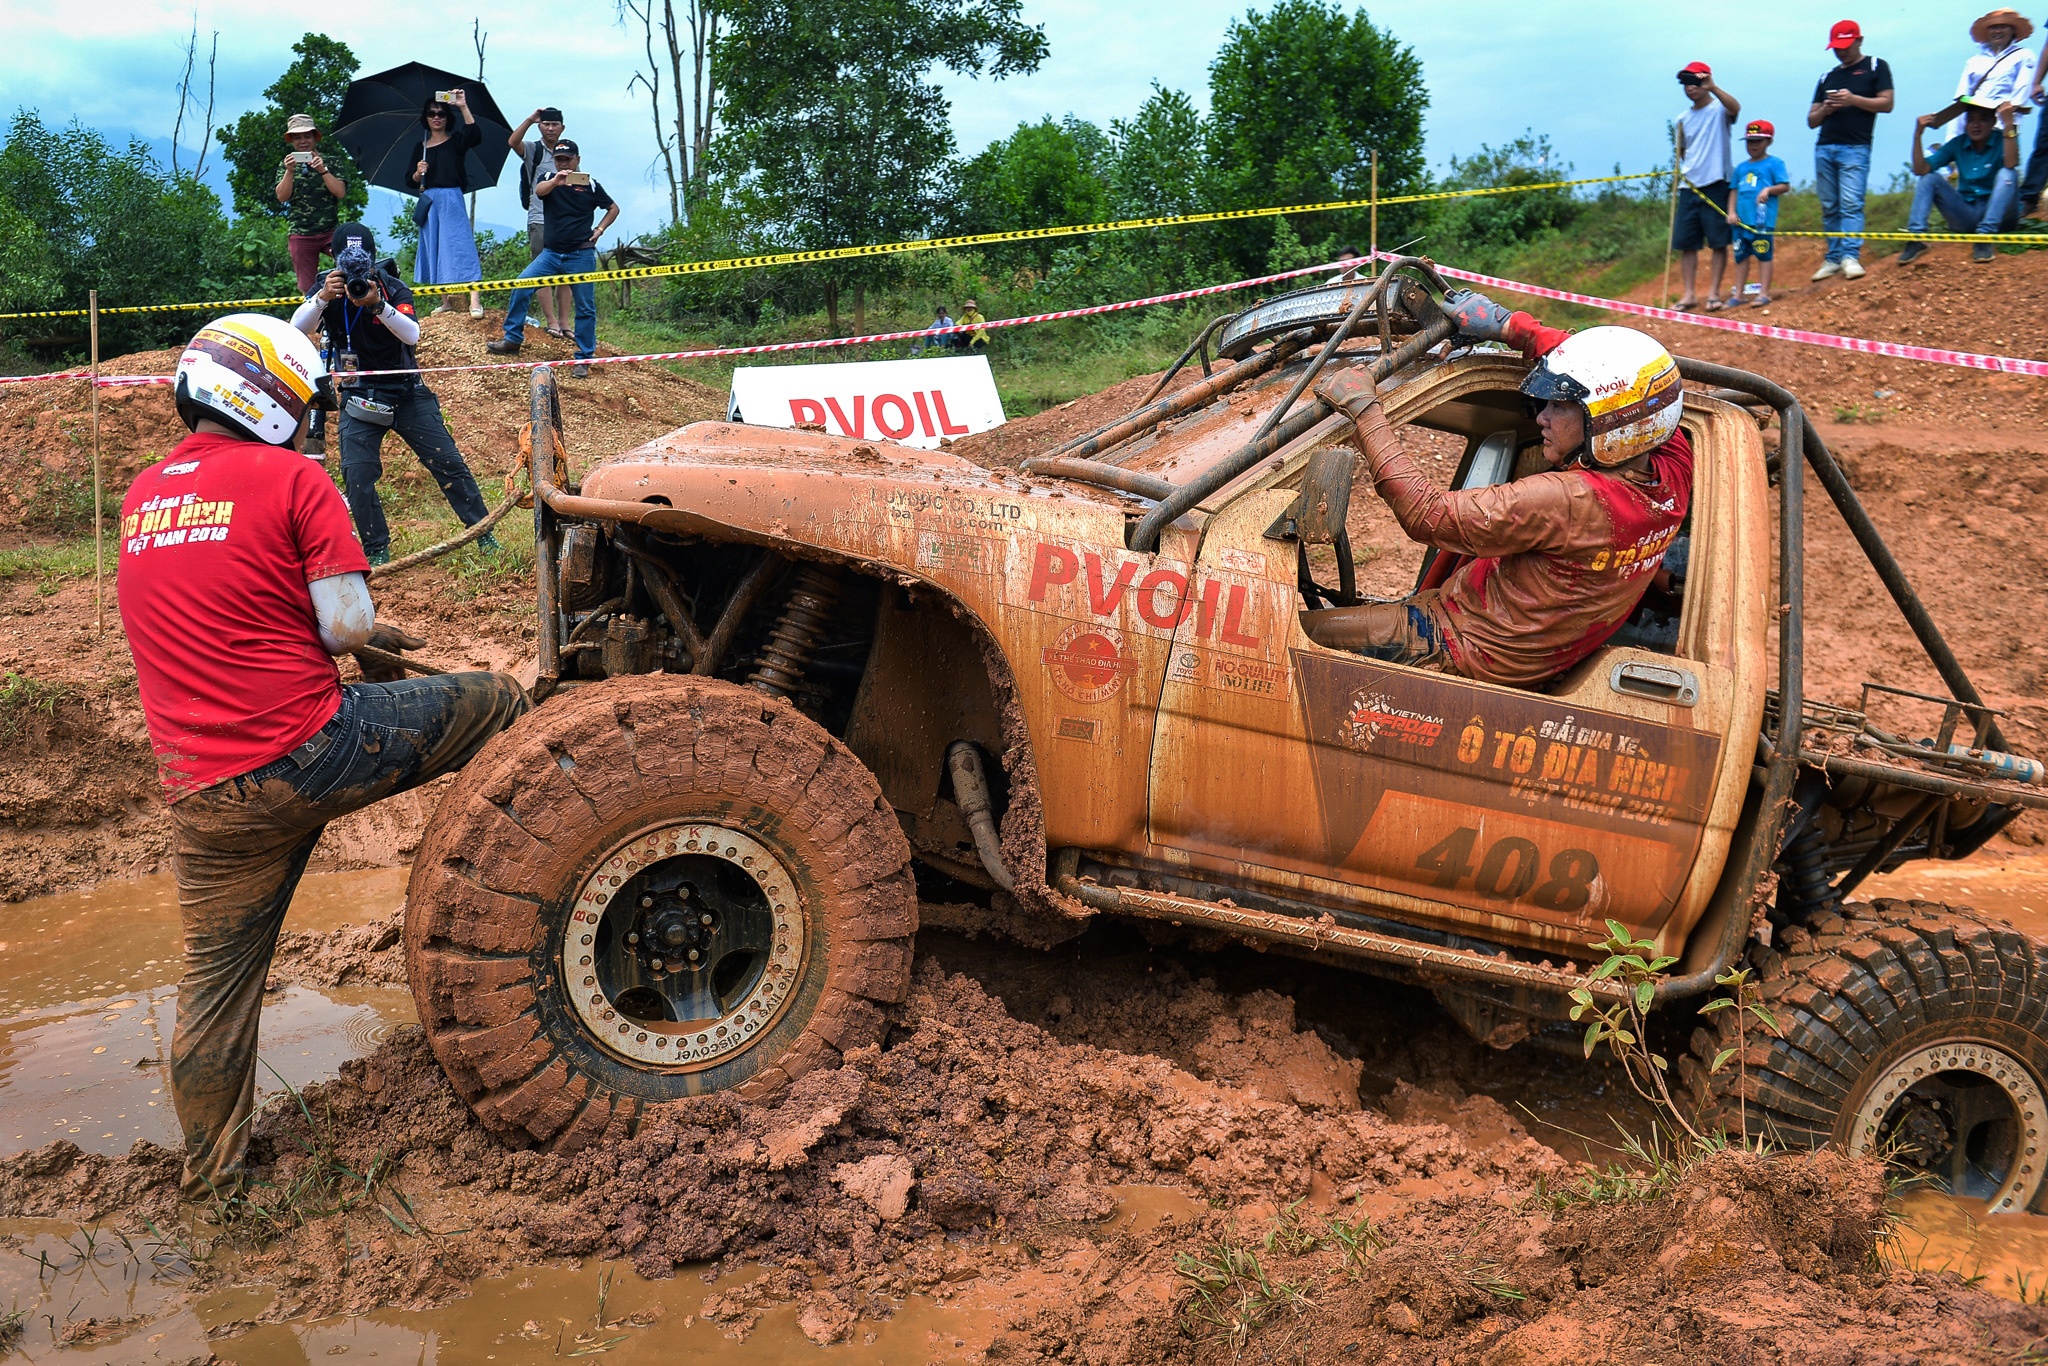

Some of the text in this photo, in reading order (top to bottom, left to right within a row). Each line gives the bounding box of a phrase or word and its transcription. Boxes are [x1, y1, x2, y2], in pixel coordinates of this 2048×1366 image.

[283, 353, 310, 381] PVOIL
[1595, 379, 1629, 396] PVOIL
[789, 390, 970, 440] PVOIL
[989, 502, 1021, 519] LTD
[153, 529, 187, 548] NAM
[188, 526, 229, 543] 2018
[1028, 542, 1260, 649] PVOIL
[1176, 667, 1200, 676] TOYOTA
[1215, 659, 1289, 683] NO QUALITY
[1221, 674, 1277, 694] NO LIFE
[1354, 709, 1443, 737] OFFROAD
[1390, 708, 1444, 724] VIETNAM
[1378, 729, 1435, 747] CUP 2018
[1457, 715, 1485, 764] Ô
[1492, 724, 1537, 774] TÔ
[1614, 734, 1641, 756] XE
[1563, 788, 1622, 816] NAM
[1621, 799, 1679, 827] 2018
[574, 827, 701, 923] BEADLOCK
[1415, 827, 1599, 912] 408
[760, 993, 783, 1018] live
[744, 1019, 760, 1033] to
[675, 1030, 741, 1061] discover
[1929, 1048, 1950, 1060] We
[1953, 1048, 1977, 1057] live
[1980, 1050, 1993, 1061] to
